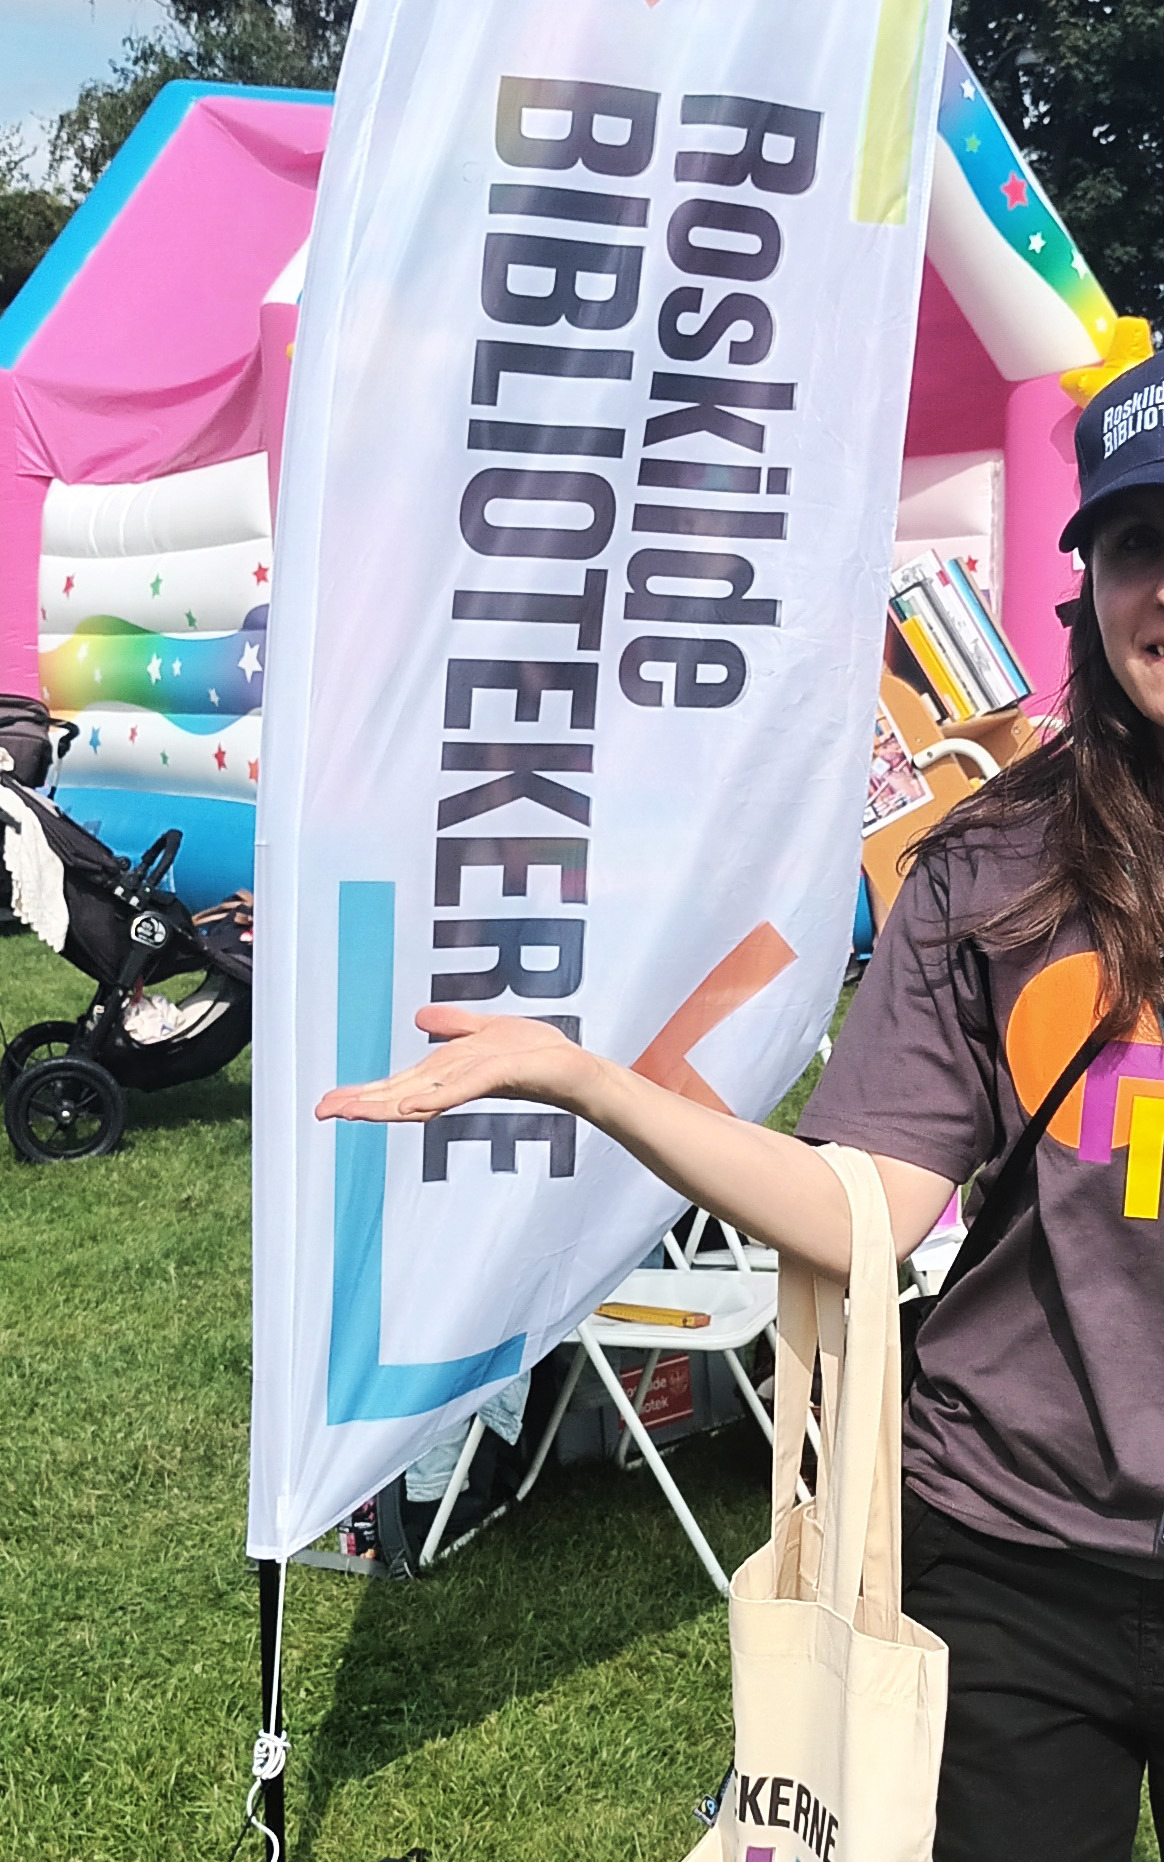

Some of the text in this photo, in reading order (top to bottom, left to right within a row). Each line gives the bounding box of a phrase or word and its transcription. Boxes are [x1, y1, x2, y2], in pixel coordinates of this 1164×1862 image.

[422, 74, 661, 1183] BIBLIOTEKERE
[618, 93, 825, 709] Roskilde
[735, 1768, 839, 1862] KERNE
